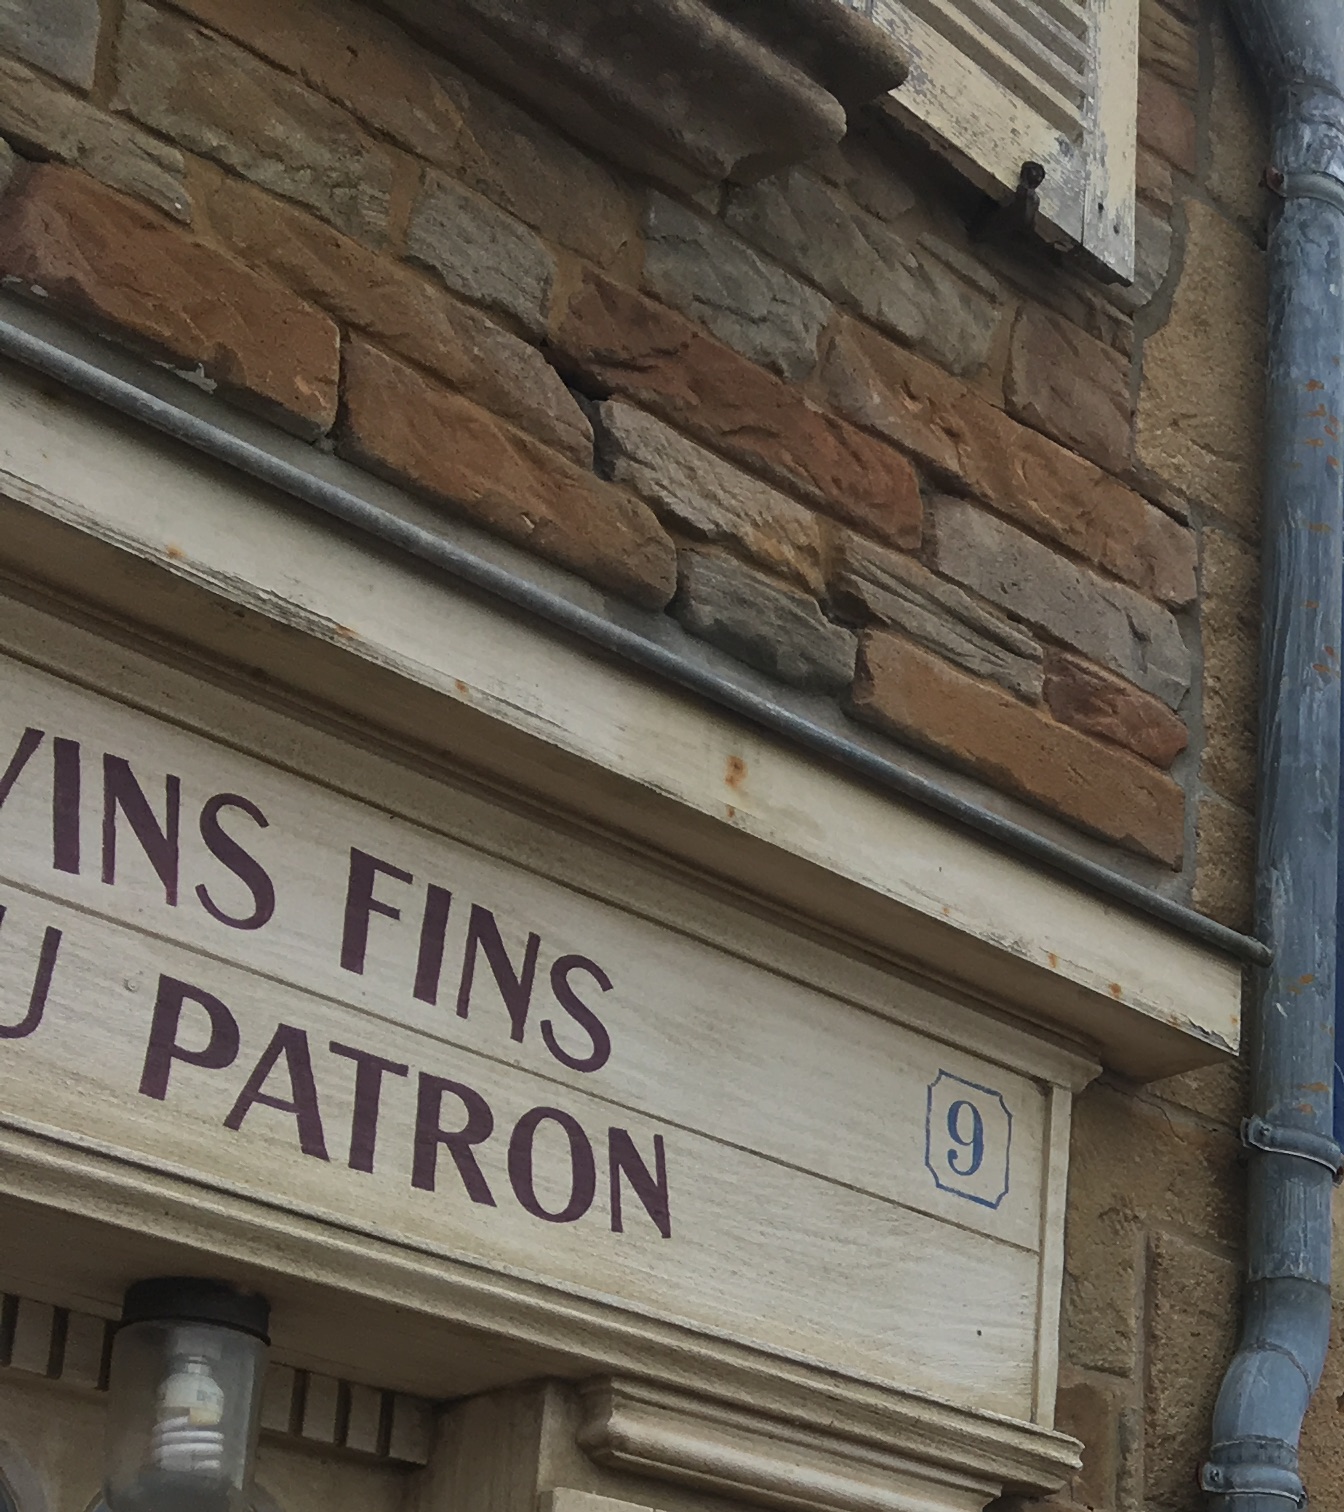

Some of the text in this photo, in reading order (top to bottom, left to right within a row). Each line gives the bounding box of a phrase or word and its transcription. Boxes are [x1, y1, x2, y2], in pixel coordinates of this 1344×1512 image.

[339, 847, 615, 1073] FINS
[138, 972, 673, 1240] PATRON
[946, 1098, 986, 1177] 9
